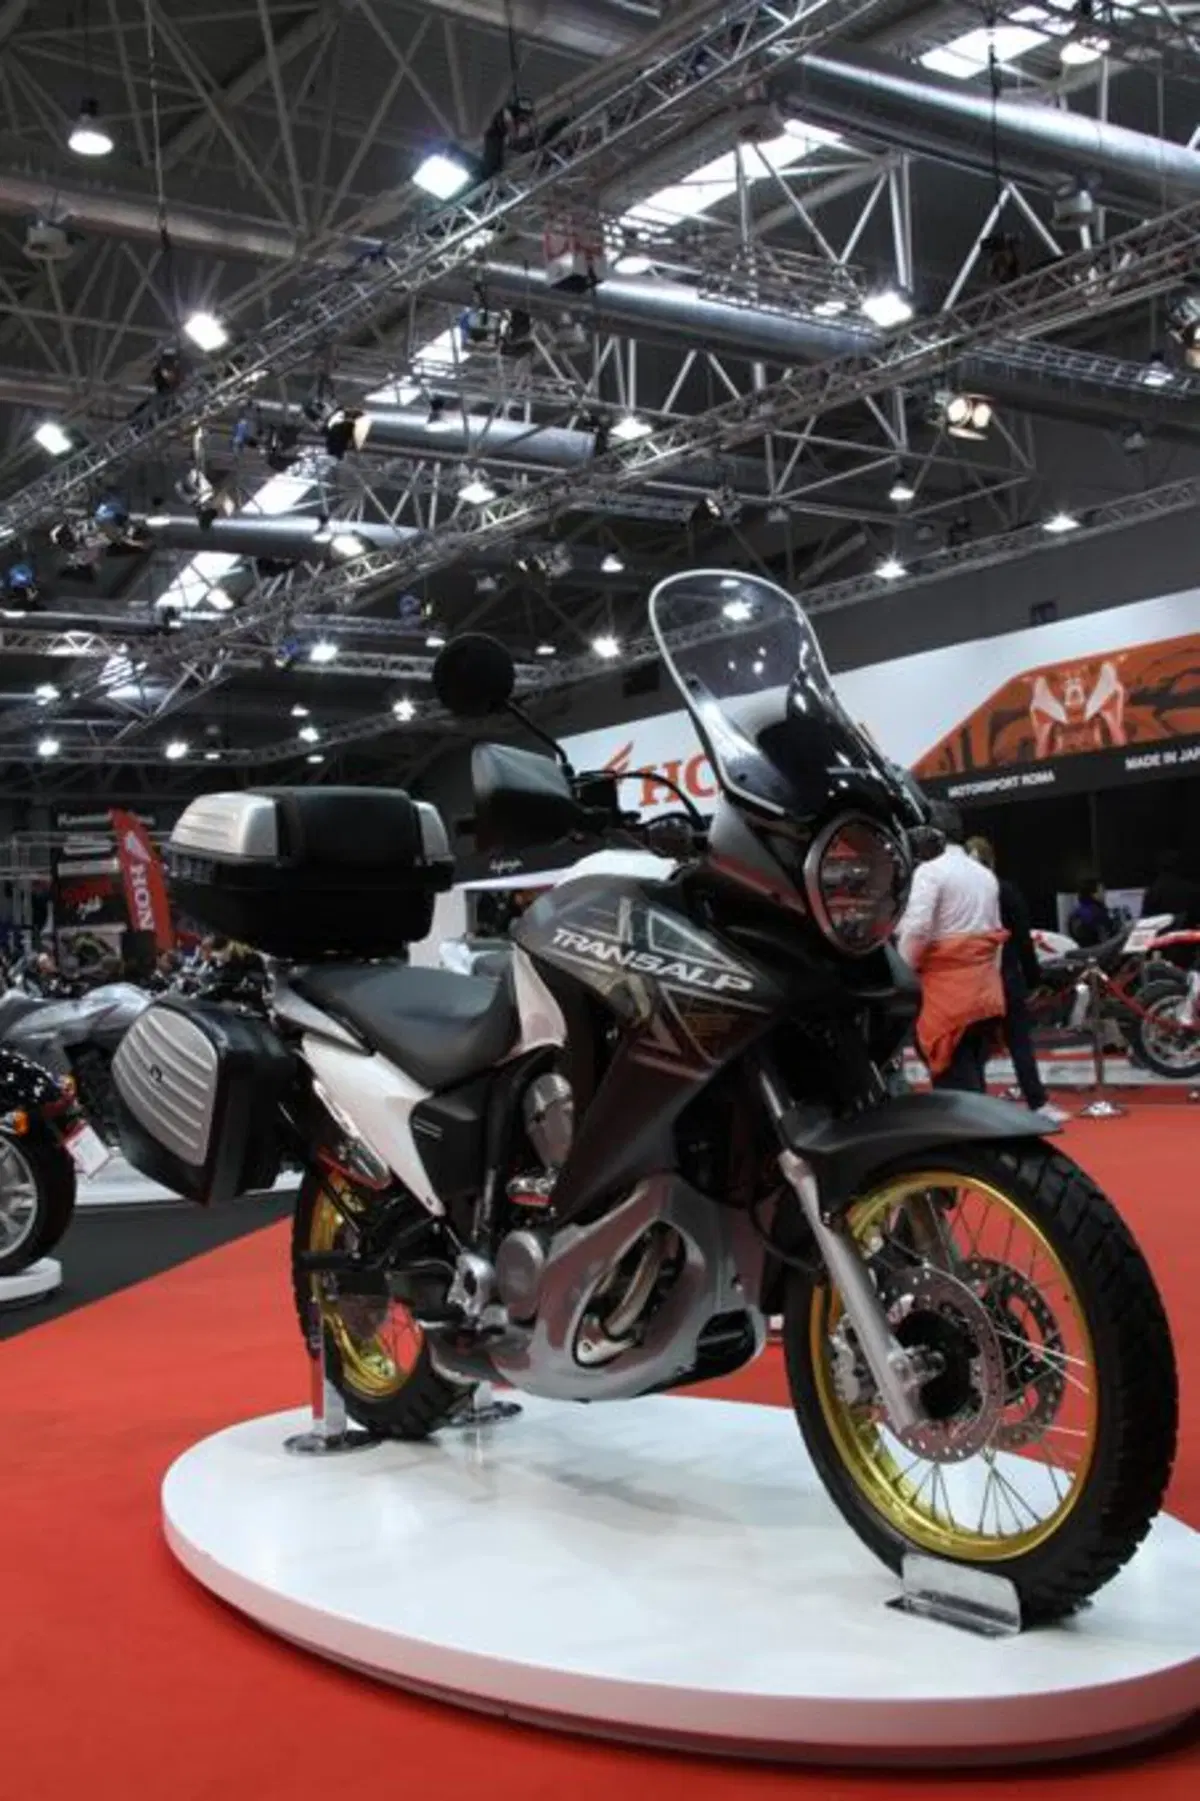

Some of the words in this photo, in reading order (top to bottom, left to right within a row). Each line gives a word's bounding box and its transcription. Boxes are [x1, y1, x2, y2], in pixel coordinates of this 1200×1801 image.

[1125, 753, 1161, 770] MADE
[1162, 750, 1178, 764] IN
[948, 775, 1019, 799] MOTORSPORT
[1021, 768, 1056, 786] ROMA
[551, 927, 754, 992] TRANSALP
